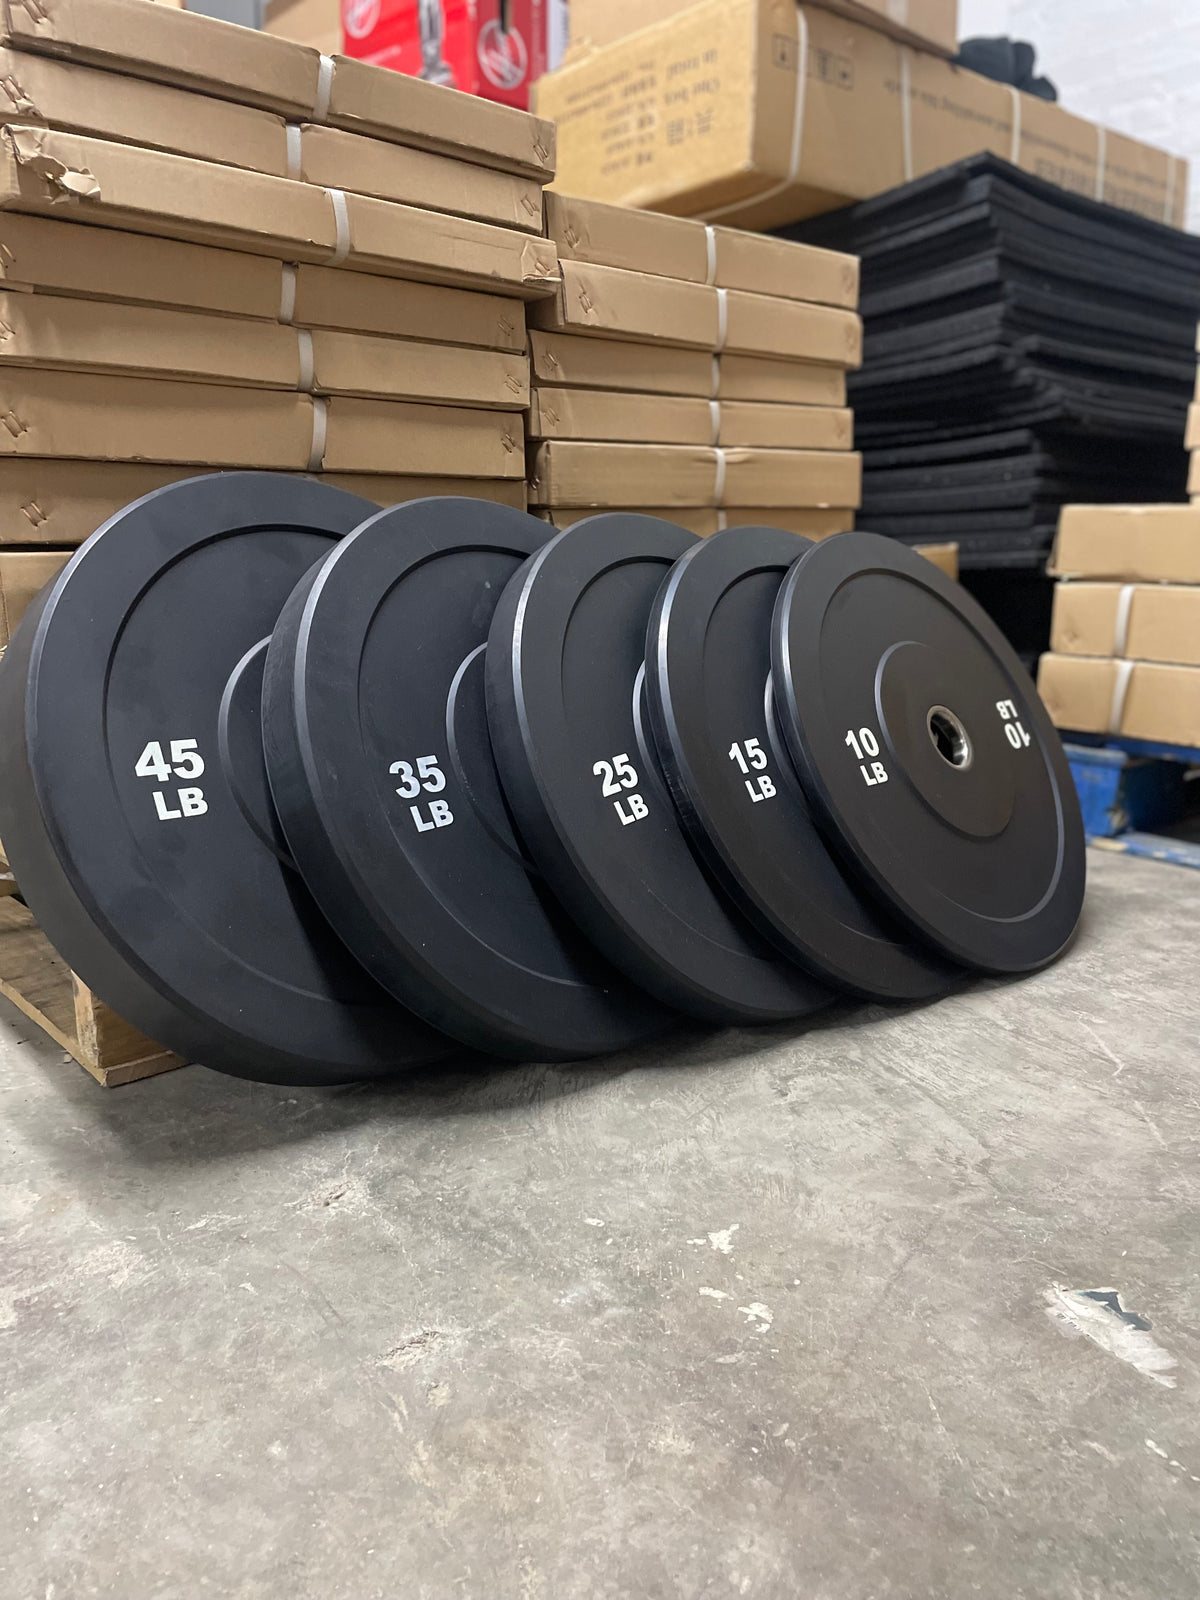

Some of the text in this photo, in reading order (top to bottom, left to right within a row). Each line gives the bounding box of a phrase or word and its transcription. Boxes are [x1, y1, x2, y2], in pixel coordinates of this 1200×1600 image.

[996, 700, 1018, 719] LB
[845, 728, 879, 759] 10
[1005, 722, 1030, 749] 10
[135, 739, 204, 781] 45
[729, 738, 767, 773] 15
[390, 755, 445, 798] 35
[593, 753, 638, 797] 25
[745, 776, 776, 802] LB
[860, 762, 888, 786] LB
[153, 787, 208, 820] LB
[410, 800, 453, 832] LB
[614, 794, 648, 825] LB
